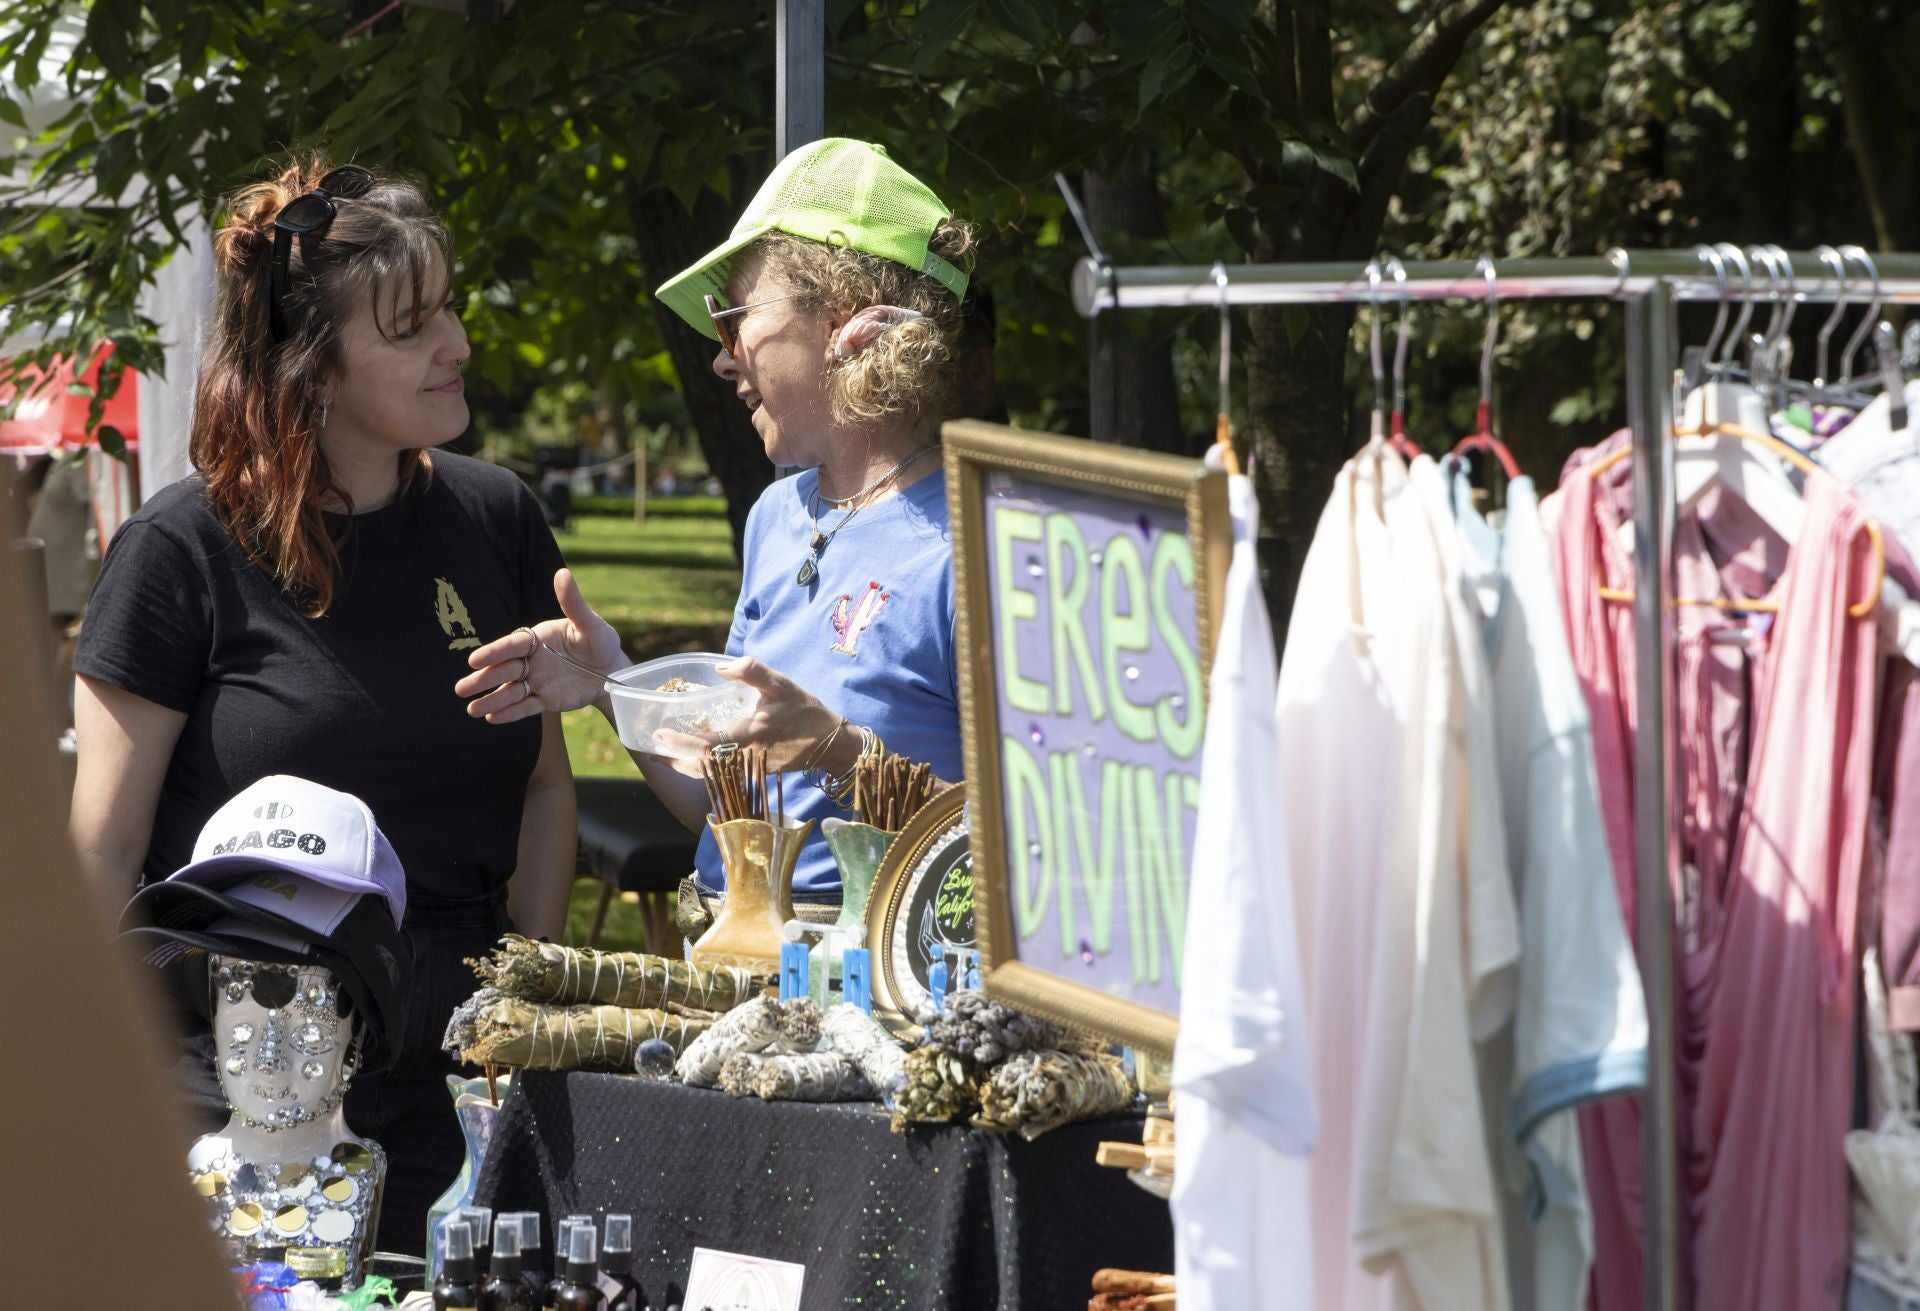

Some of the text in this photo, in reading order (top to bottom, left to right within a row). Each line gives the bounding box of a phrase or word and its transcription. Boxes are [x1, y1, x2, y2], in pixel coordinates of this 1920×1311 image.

[434, 576, 477, 637] A
[212, 828, 327, 856] MAGO
[1002, 735, 1201, 992] DIVIN
[943, 868, 977, 898] Bruj
[936, 893, 978, 930] Califor
